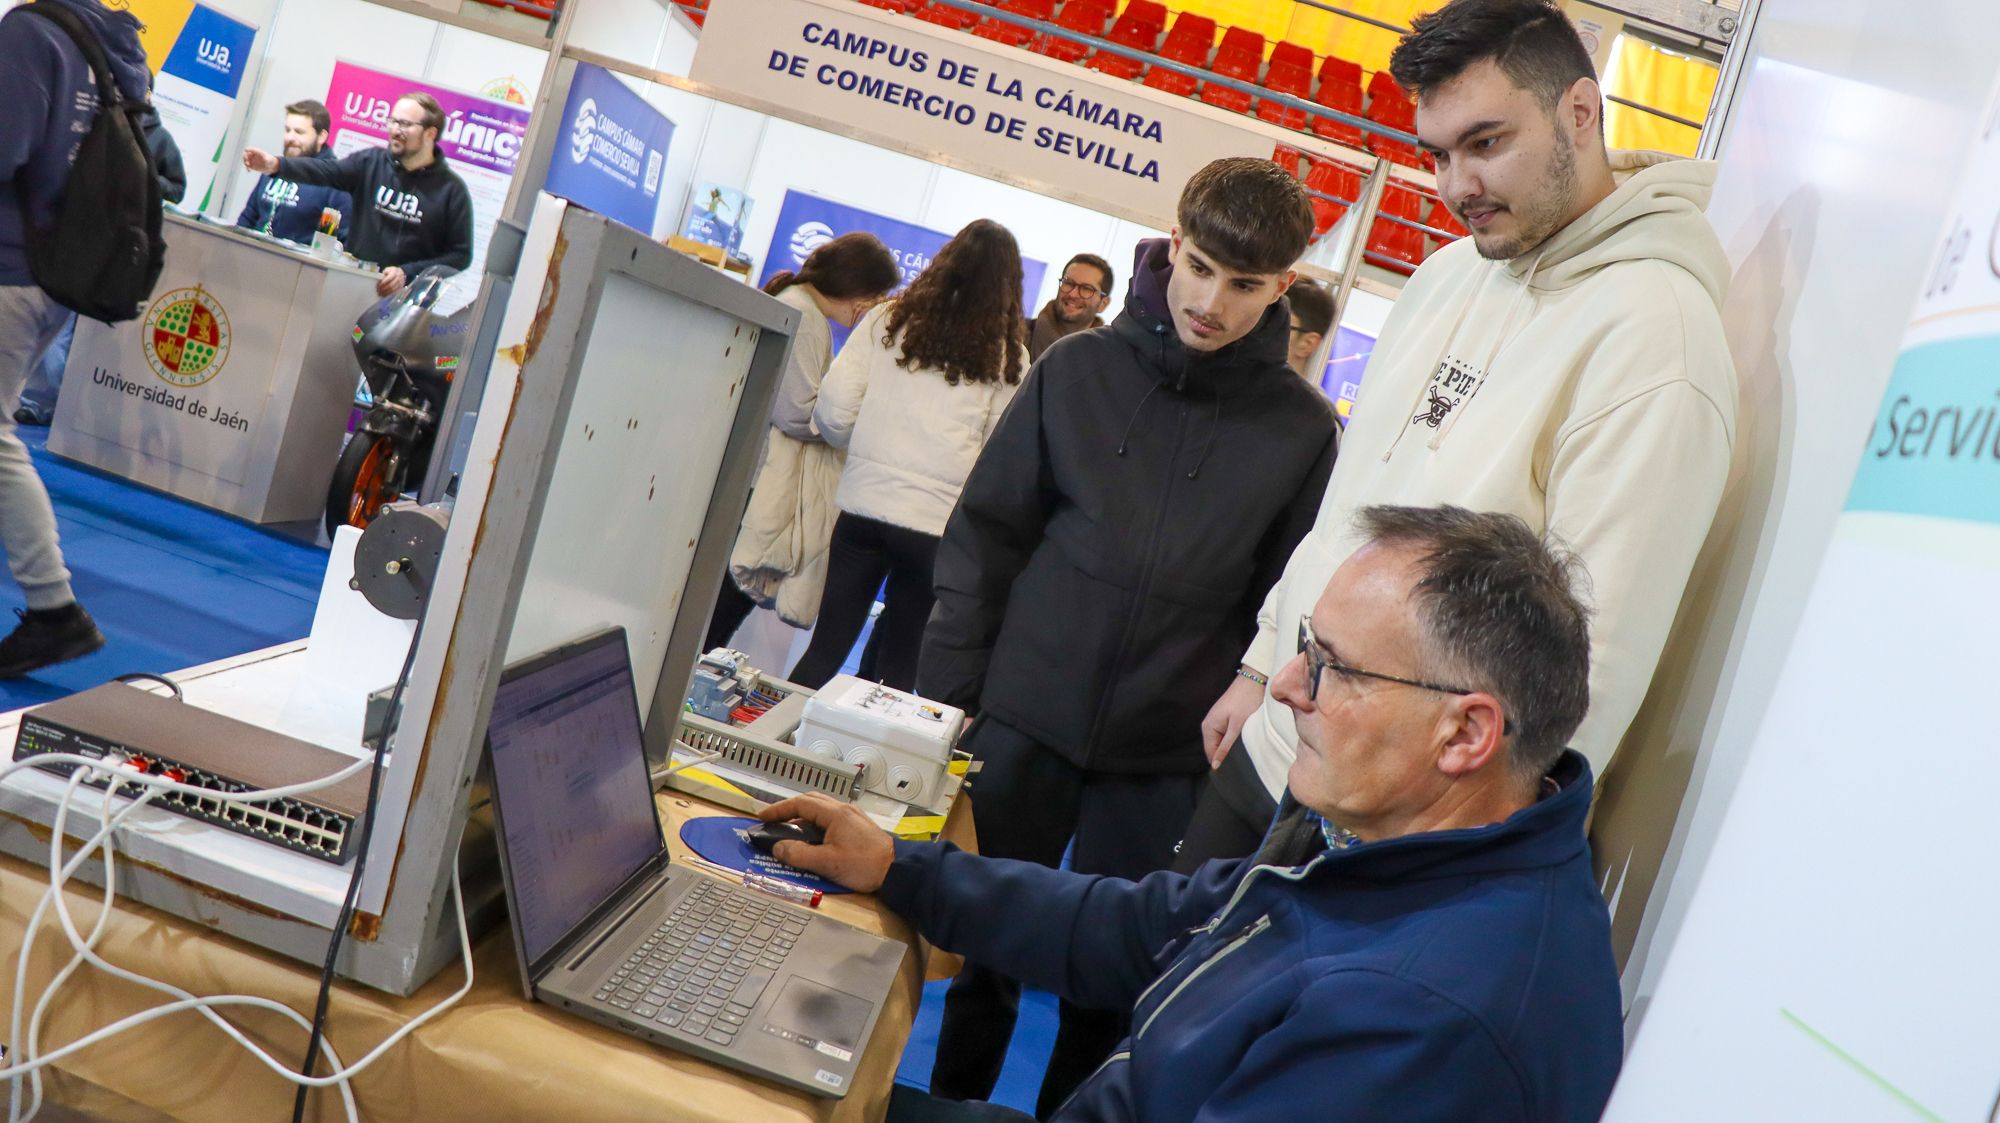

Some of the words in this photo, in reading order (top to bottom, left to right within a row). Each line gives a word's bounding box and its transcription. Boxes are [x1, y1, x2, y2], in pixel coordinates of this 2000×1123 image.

[767, 49, 807, 78] DE
[816, 65, 977, 126] COMERCIO
[984, 112, 1027, 141] DE
[1033, 126, 1161, 184] SEVILLA
[802, 21, 929, 74] CAMPUS
[936, 57, 979, 88] DE
[985, 71, 1025, 102] LA
[1034, 86, 1164, 144] CÁMARA
[592, 136, 621, 168] COMERCIO
[619, 151, 641, 177] SEVILLA
[597, 113, 623, 144] CAMPUS
[93, 366, 186, 411] Universidad
[188, 399, 208, 418] de
[210, 406, 249, 432] Jaén
[1876, 388, 2000, 460] Servi
